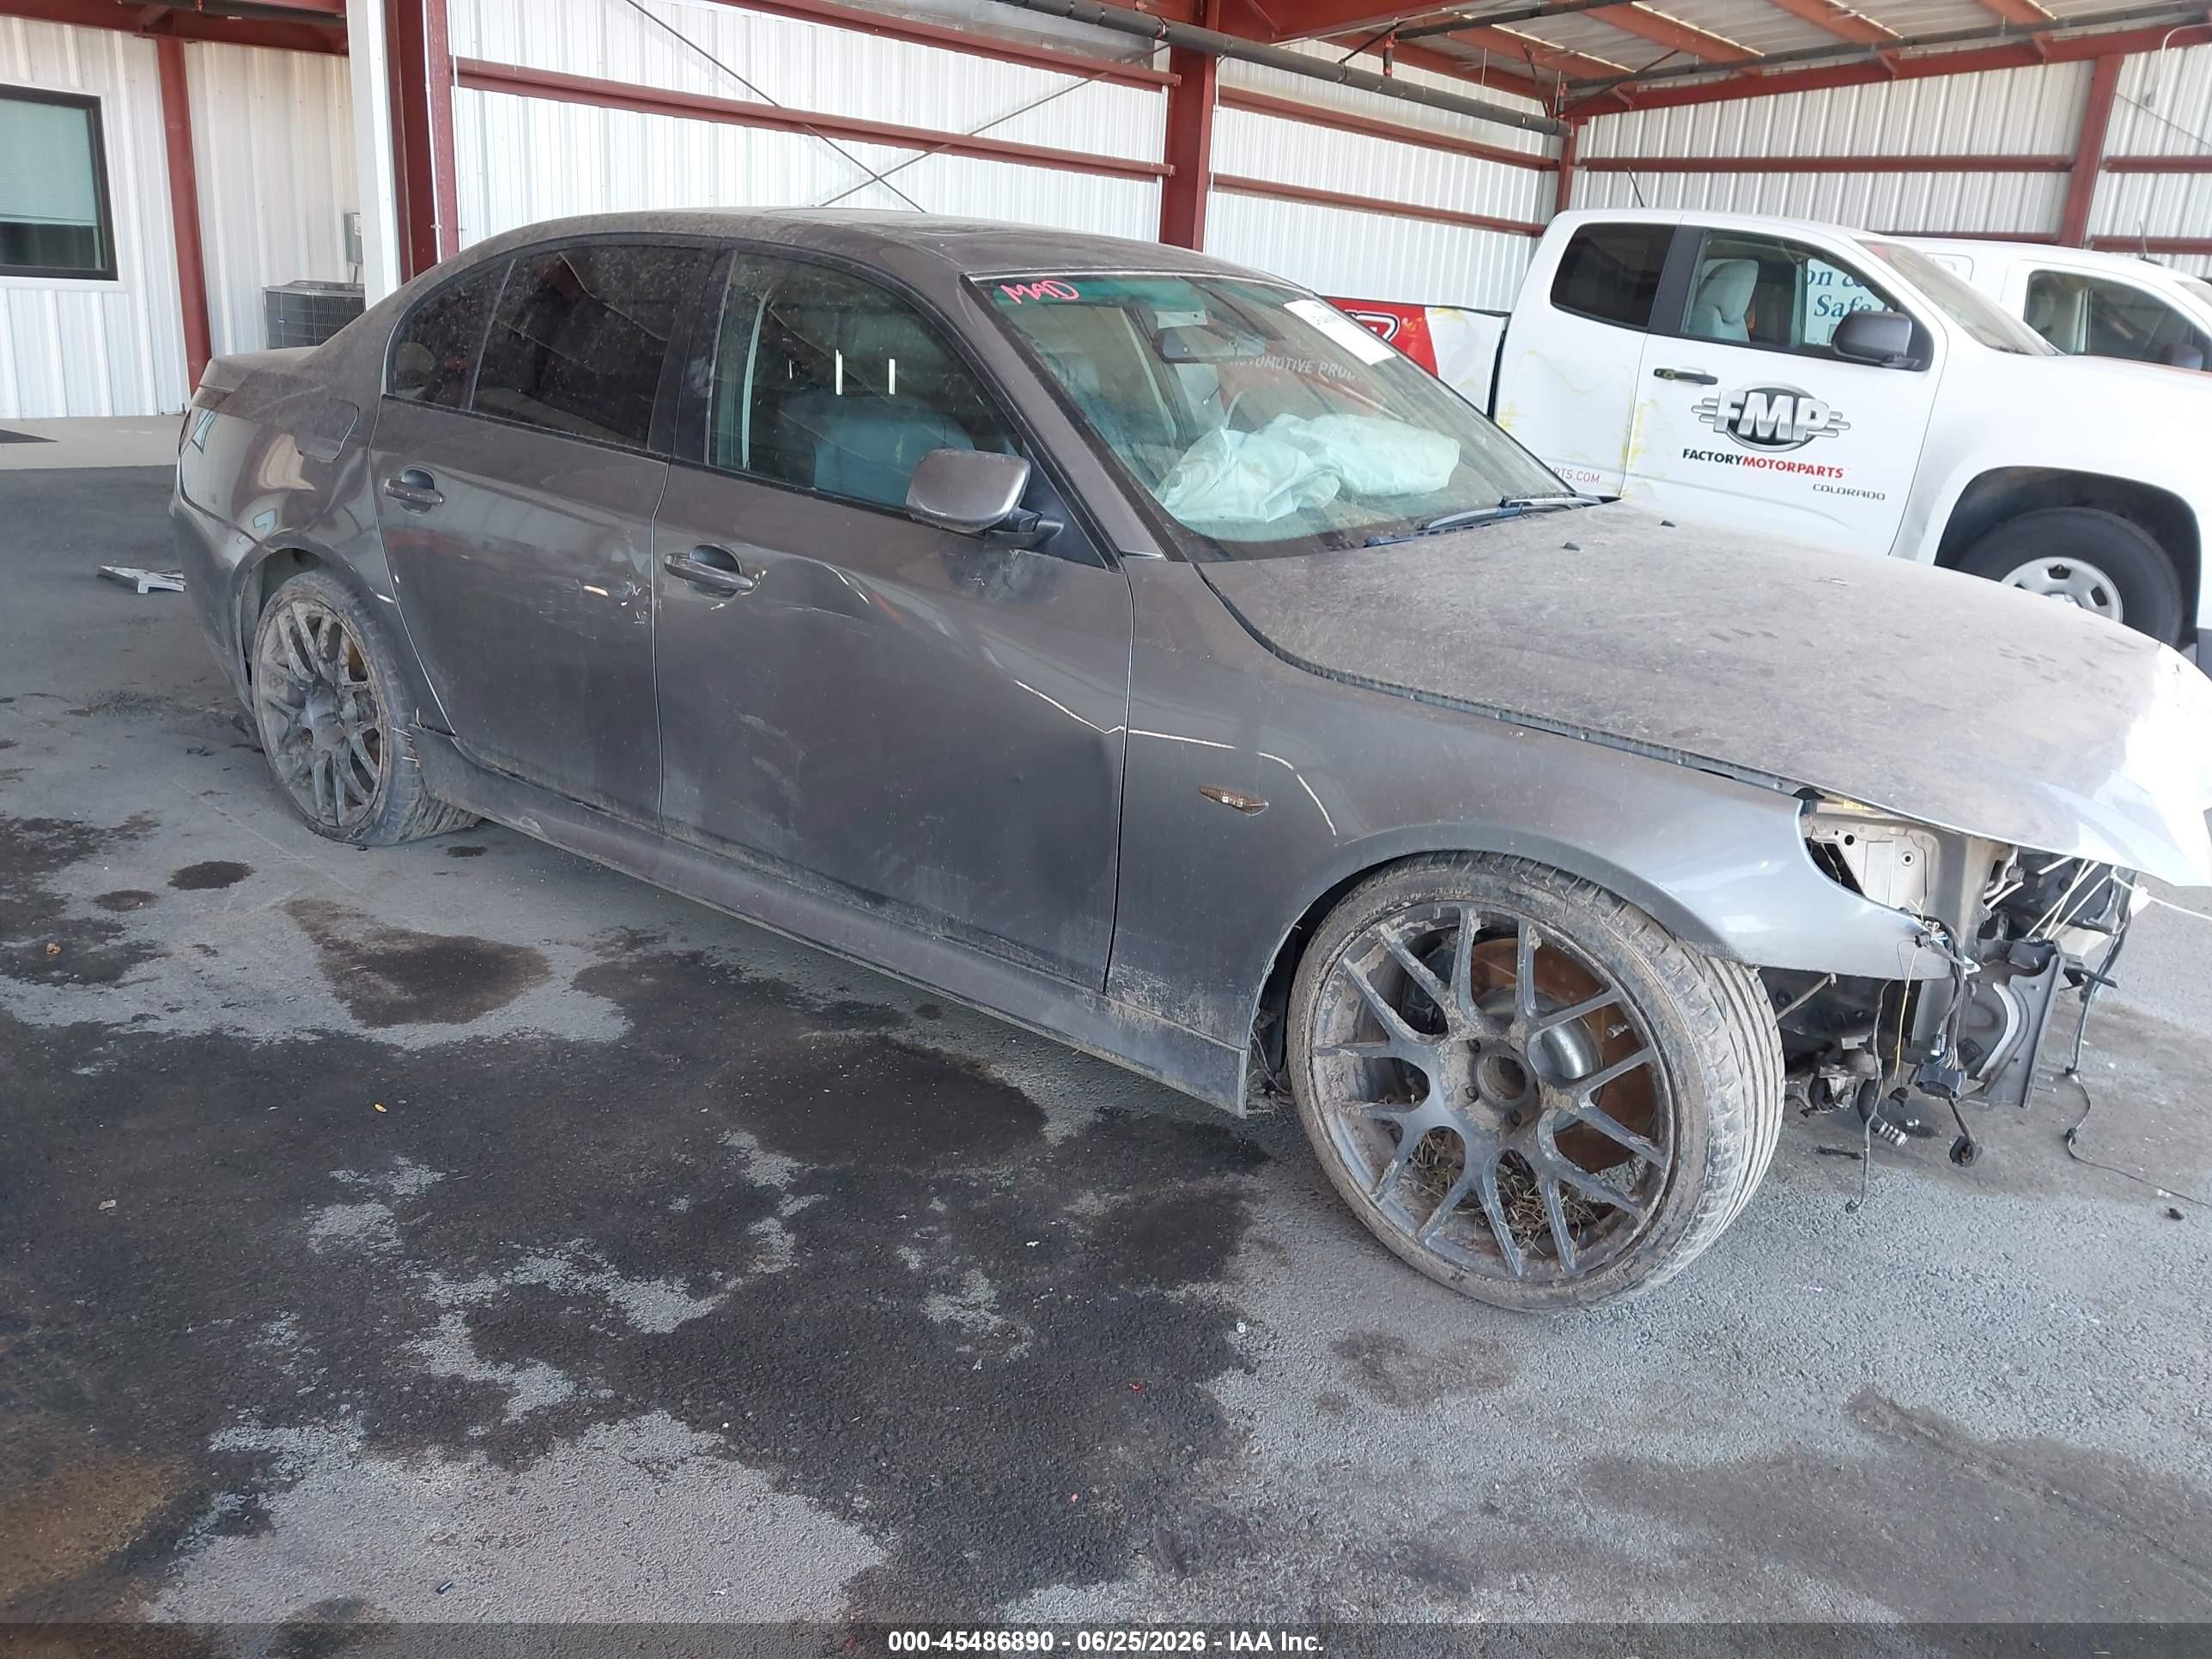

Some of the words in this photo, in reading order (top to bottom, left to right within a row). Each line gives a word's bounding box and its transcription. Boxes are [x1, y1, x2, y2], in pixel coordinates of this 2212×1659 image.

[1000, 280, 1079, 304] MAD
[1713, 391, 1830, 442] FMP
[1813, 483, 1887, 501] COLORADO
